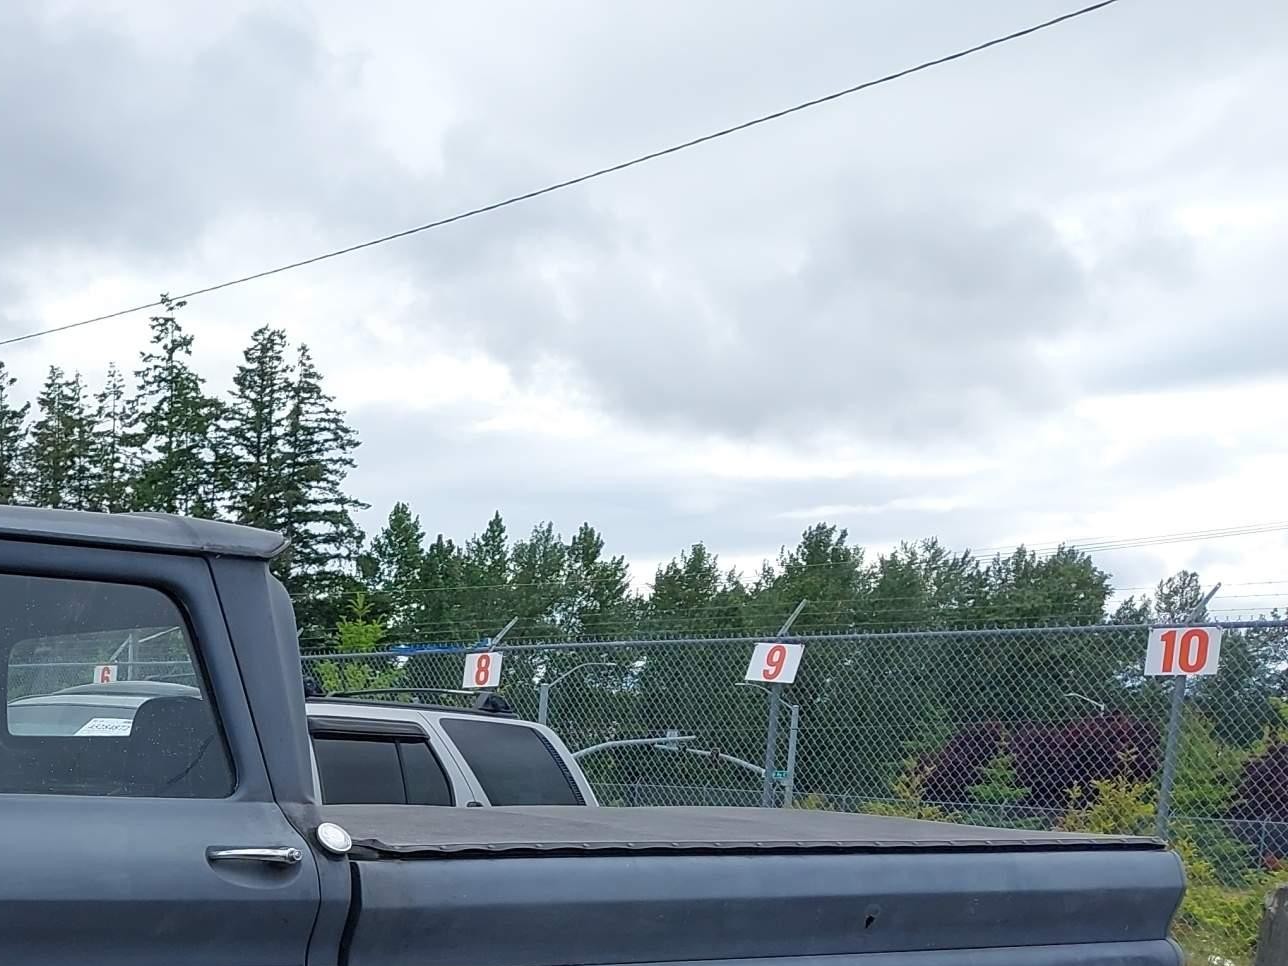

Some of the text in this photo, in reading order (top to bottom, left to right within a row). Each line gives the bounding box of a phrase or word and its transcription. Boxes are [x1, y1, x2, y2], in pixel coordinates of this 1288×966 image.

[763, 645, 786, 680] 9
[1160, 628, 1209, 673] 10
[101, 666, 111, 683] 6
[475, 654, 490, 685] 8
